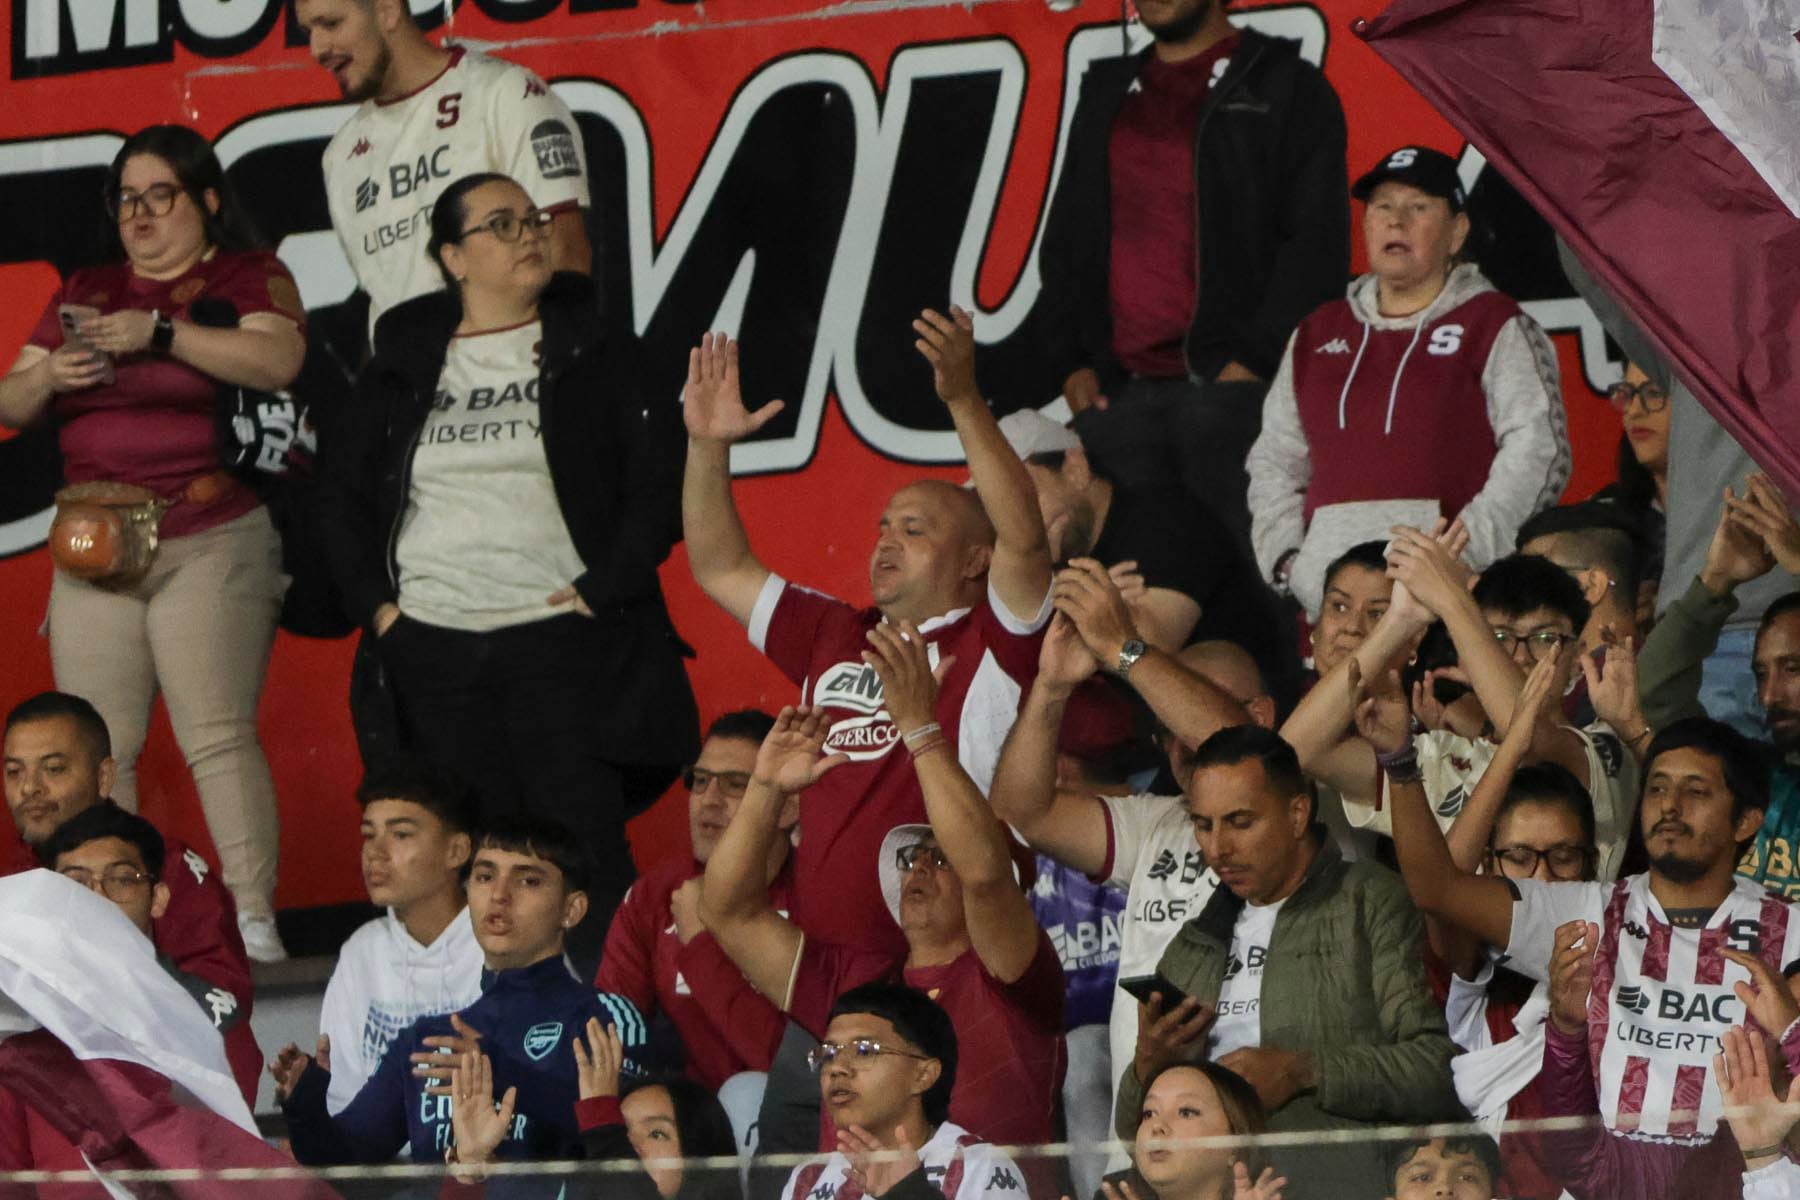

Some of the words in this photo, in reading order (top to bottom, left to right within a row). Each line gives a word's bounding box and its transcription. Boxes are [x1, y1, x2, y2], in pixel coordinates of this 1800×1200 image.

[436, 92, 463, 130] S
[388, 145, 451, 199] BAC
[1387, 149, 1418, 169] S
[1427, 324, 1465, 355] S
[1134, 894, 1199, 923] LIBE
[1077, 912, 1124, 957] BA
[1657, 988, 1736, 1024] BAC
